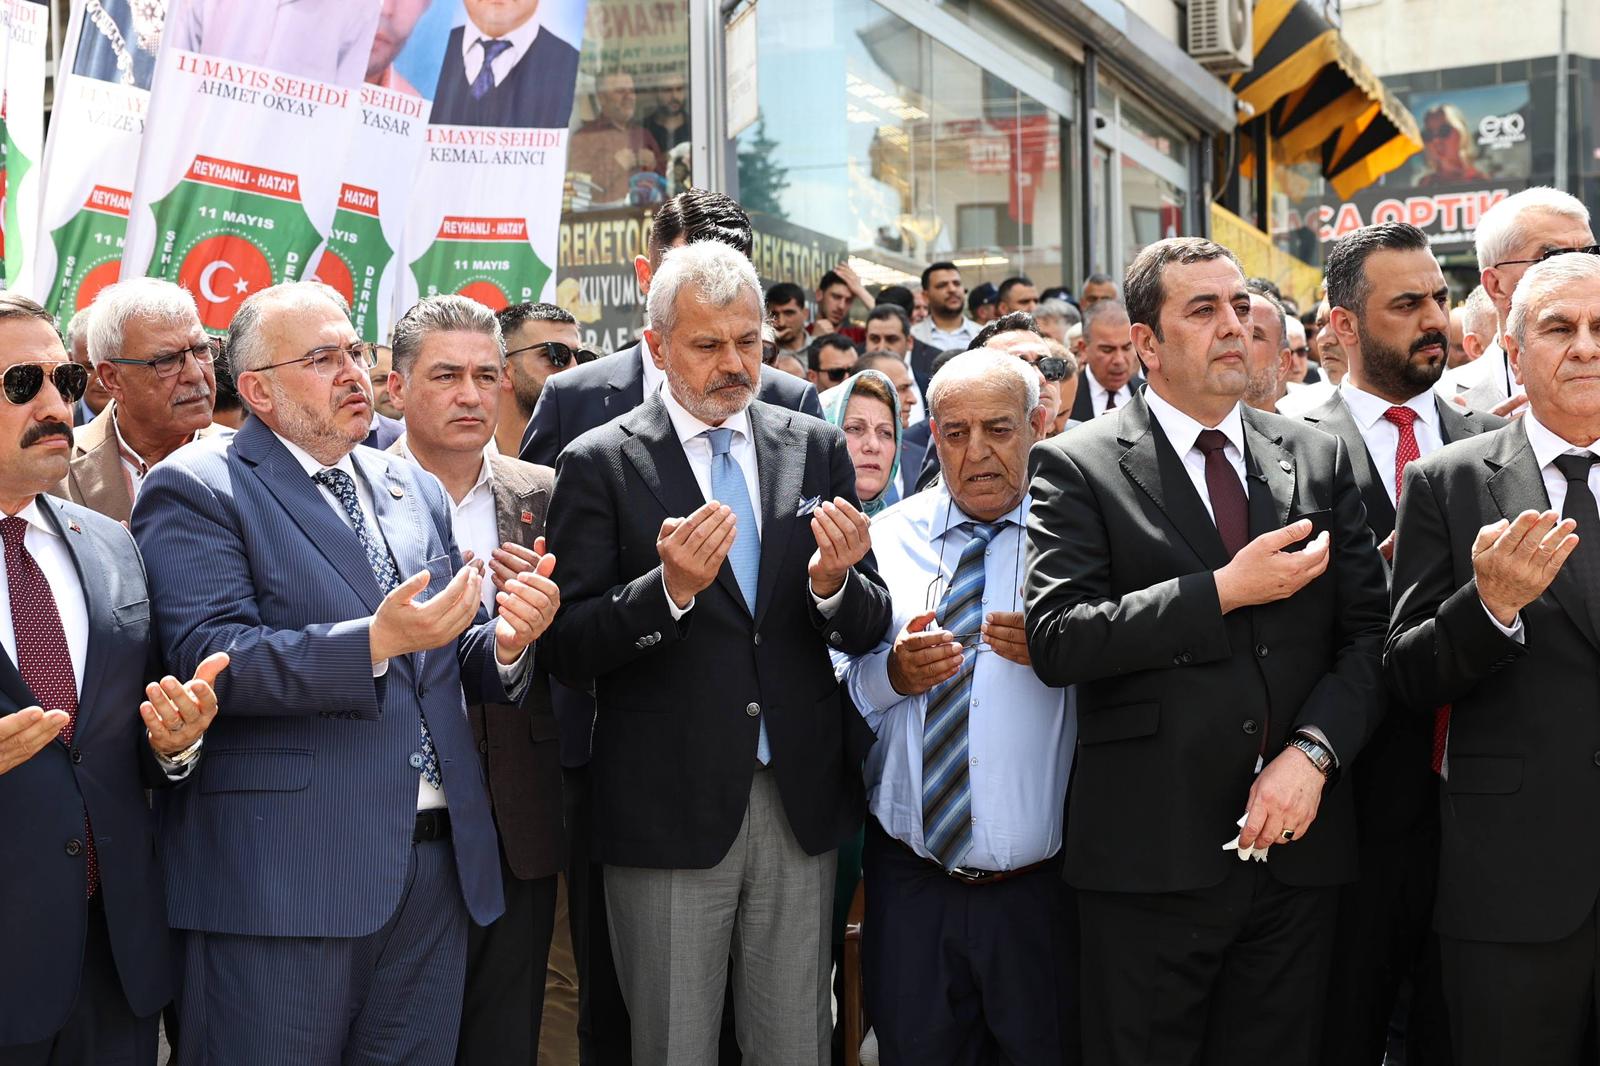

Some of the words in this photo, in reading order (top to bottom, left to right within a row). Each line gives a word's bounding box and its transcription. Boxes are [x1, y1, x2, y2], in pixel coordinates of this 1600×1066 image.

[176, 56, 198, 74] 11
[203, 60, 270, 90] MAYIS
[198, 79, 261, 104] AHMET
[263, 93, 318, 118] OKYAY
[362, 109, 411, 137] YAŞAR
[439, 129, 496, 145] MAYIS
[430, 147, 488, 164] KEMAL
[491, 150, 546, 165] AKINCI
[193, 160, 250, 184] REYHANLI
[257, 173, 296, 193] HATAY
[344, 189, 377, 209] HATAY
[198, 206, 217, 219] 11
[222, 210, 274, 230] MAYIS
[443, 221, 490, 234] REYHANLI
[497, 222, 524, 235] HATAY
[94, 233, 111, 245] 11
[454, 260, 468, 270] 11
[472, 260, 510, 270] MAYIS
